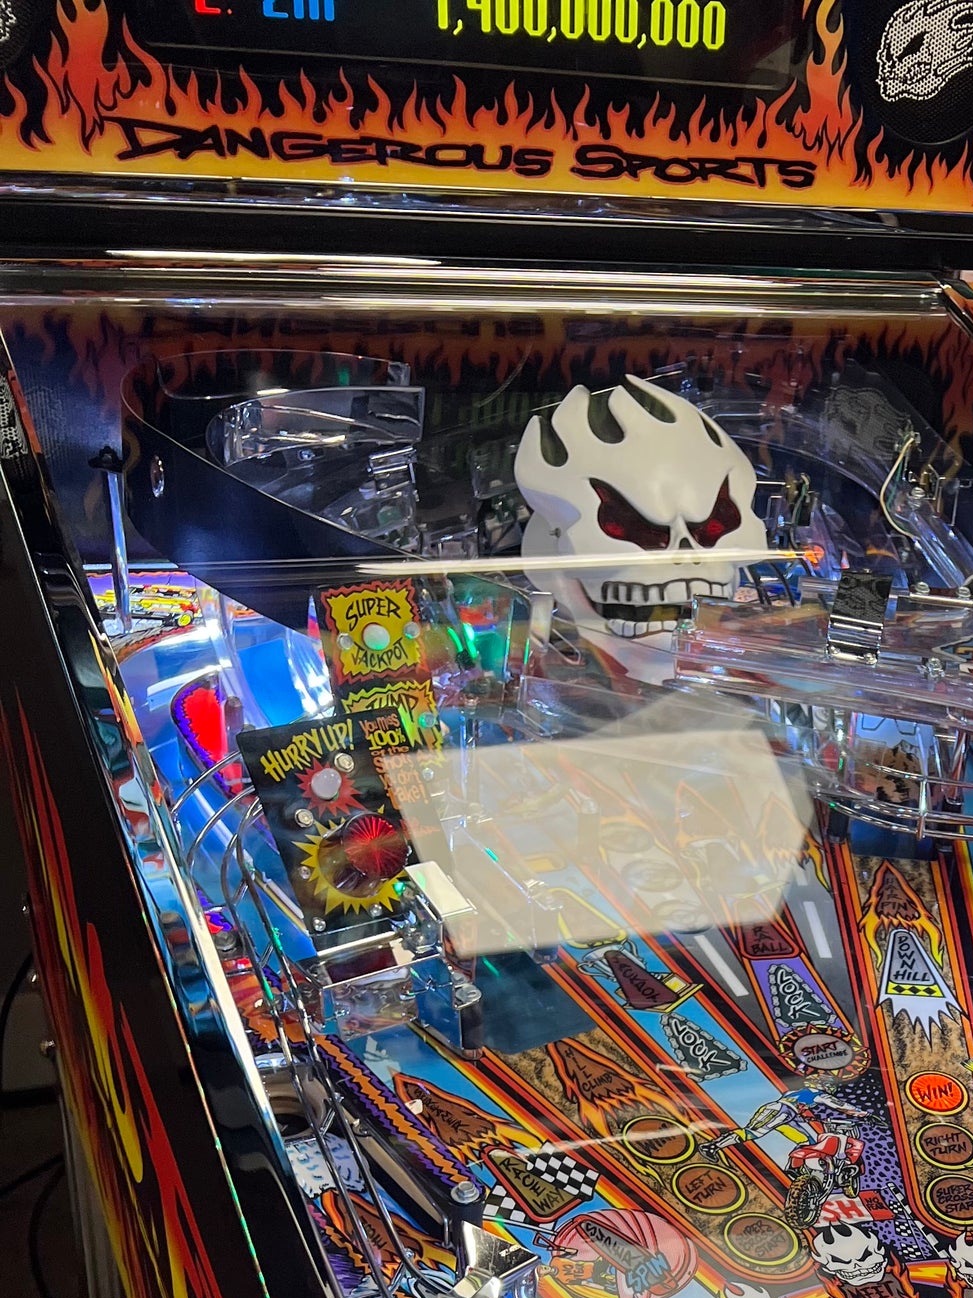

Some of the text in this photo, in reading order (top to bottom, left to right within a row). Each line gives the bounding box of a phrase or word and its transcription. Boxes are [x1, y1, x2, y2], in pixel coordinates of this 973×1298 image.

[102, 115, 818, 190] DANGEROUS SPORTS
[346, 596, 401, 632] SUPER
[352, 638, 408, 669] JACKPOT
[260, 719, 354, 783] HURRY UP!
[881, 903, 907, 912] PIN
[752, 945, 788, 954] BALL
[898, 935, 915, 969] DOWN
[893, 969, 930, 981] HILL
[776, 968, 824, 1020] LOCK
[671, 1018, 732, 1073] LOCK
[801, 1041, 840, 1056] START
[806, 1050, 848, 1063] CHALLENGE
[565, 1050, 592, 1079] HILL
[582, 1074, 613, 1092] CLIMB
[917, 1082, 953, 1102] WIN!
[924, 1131, 962, 1147] RIGHT
[931, 1141, 967, 1156] TURN
[501, 1158, 546, 1197] RACE
[684, 1170, 712, 1194] LEFT
[691, 1177, 727, 1204] TURN
[936, 1183, 972, 1198] SUPER
[533, 1186, 565, 1213] WAY
[627, 1252, 671, 1292] SPIN
